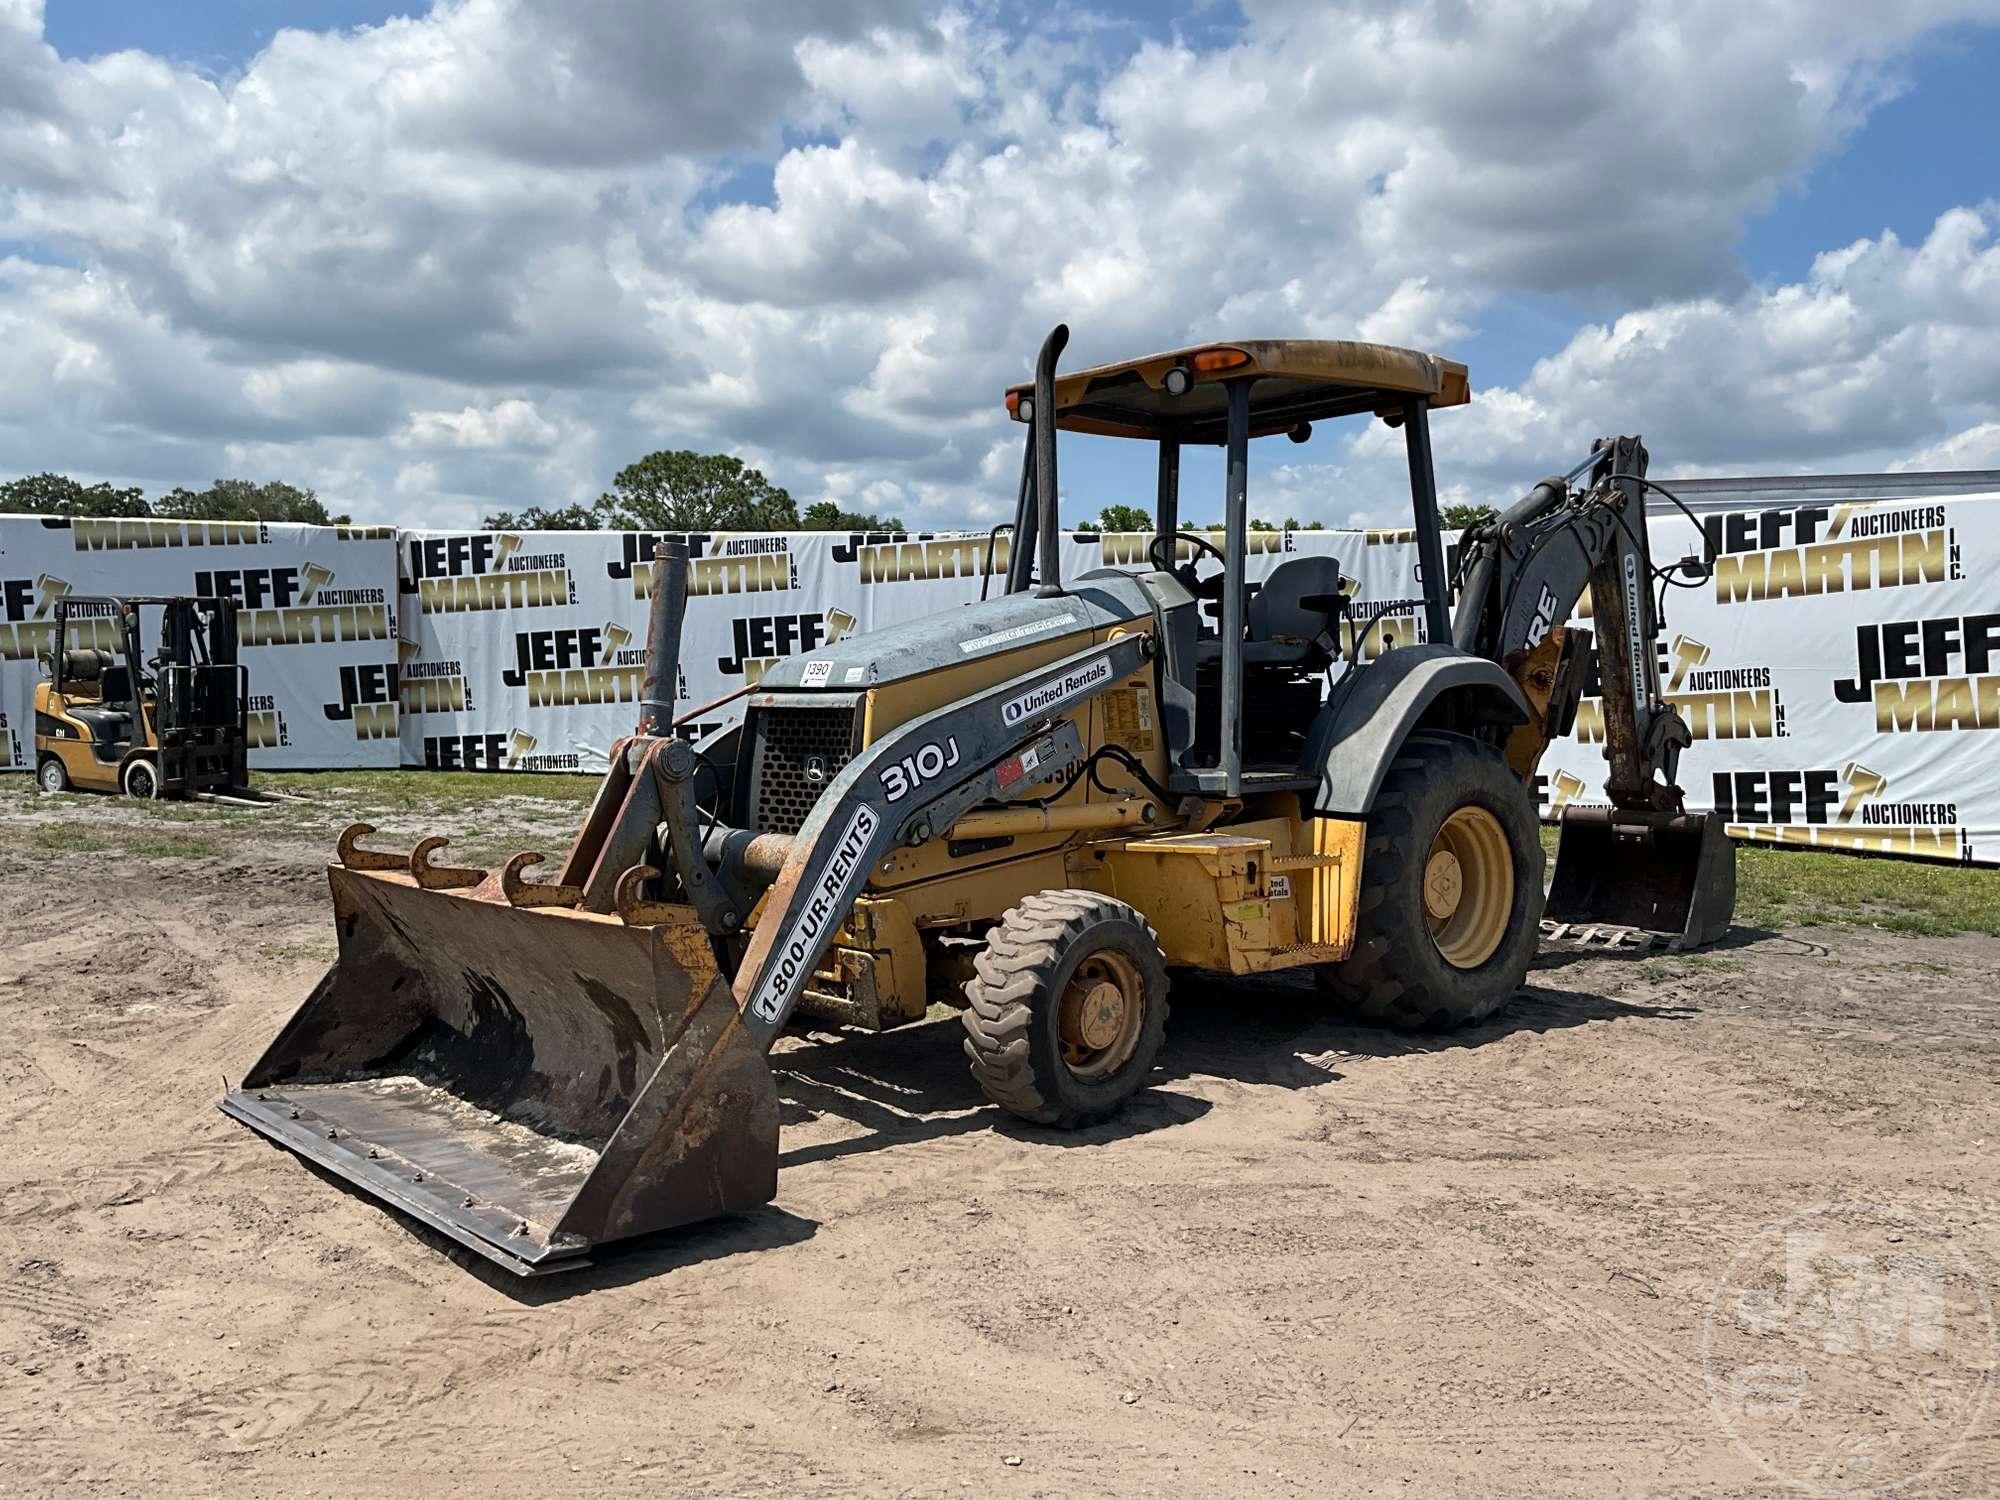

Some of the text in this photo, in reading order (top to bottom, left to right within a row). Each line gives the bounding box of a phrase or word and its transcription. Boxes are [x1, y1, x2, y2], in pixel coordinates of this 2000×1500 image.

[1851, 505, 1946, 539] AUCTIONEERS
[400, 535, 494, 594] JEFF
[508, 553, 565, 571] AUCTIONEERS
[727, 537, 787, 556] AUCTIONEERS
[1716, 530, 1945, 604] MARTIN
[317, 588, 384, 606] AUCTIONEERS
[420, 570, 567, 615] MARTIN
[502, 628, 602, 687] JEFF
[718, 613, 825, 674] JEFF
[1628, 583, 1645, 701] United Rentals
[1834, 614, 2000, 704] JEFF
[406, 661, 461, 678] AUCTIONEERS
[807, 663, 829, 675] 1390
[1023, 664, 1107, 712] United Rentals
[1689, 667, 1771, 691] AUCTIONEERS
[522, 753, 579, 771] AUCTIONEERS
[880, 735, 960, 801] 310J
[1862, 803, 1957, 825] AUCTIONEERS
[762, 812, 872, 1014] 1-800-UR-RENTS
